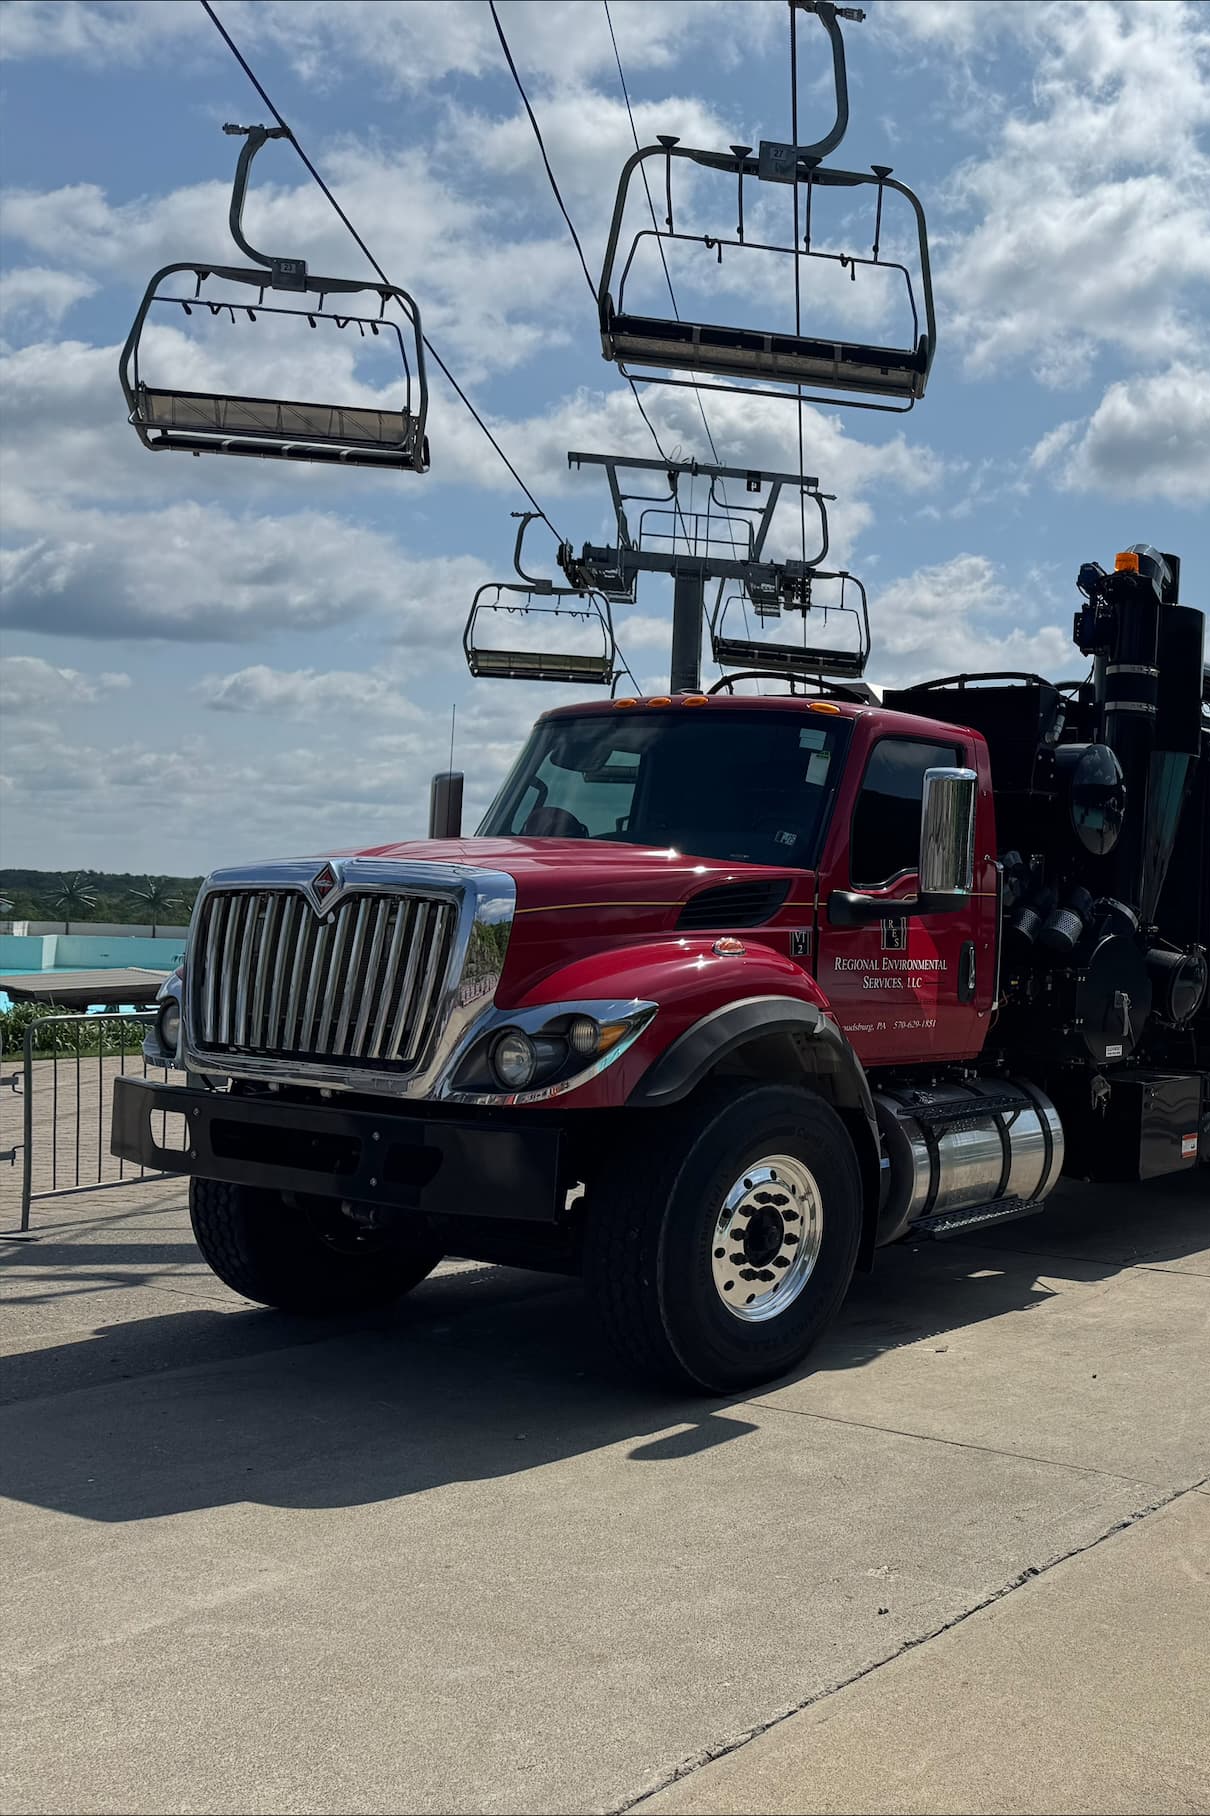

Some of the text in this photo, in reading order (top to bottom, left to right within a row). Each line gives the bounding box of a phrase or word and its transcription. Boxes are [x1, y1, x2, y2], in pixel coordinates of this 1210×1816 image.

[797, 944, 804, 954] 2
[834, 957, 948, 970] REGIONAL ENVIRONMENTAL
[863, 975, 923, 989] SERVICES, LLC
[876, 1021, 887, 1031] PA
